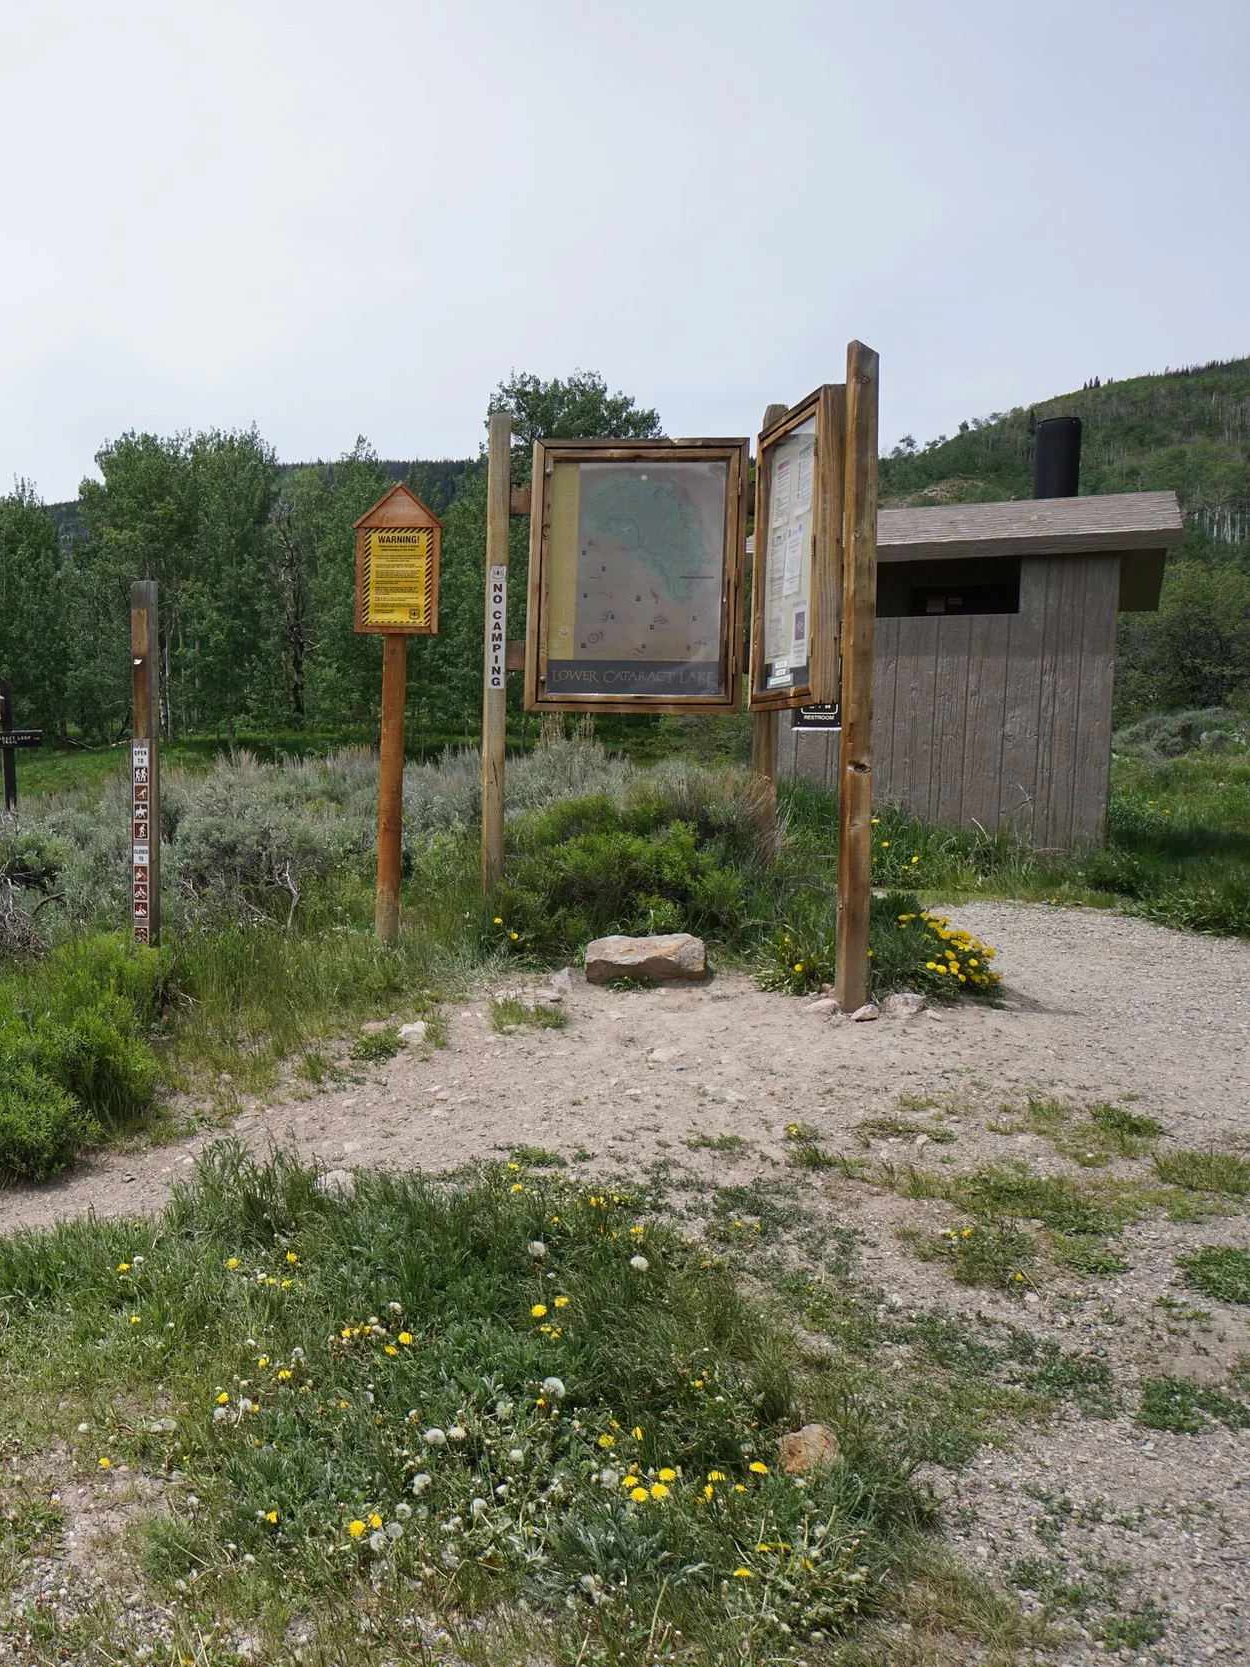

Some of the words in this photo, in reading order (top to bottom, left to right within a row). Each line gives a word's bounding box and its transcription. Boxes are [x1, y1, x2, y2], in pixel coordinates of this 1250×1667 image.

[377, 535, 420, 544] WARNING!
[492, 583, 503, 604] NO
[491, 610, 503, 686] CAMPING
[552, 670, 599, 683] LOWER
[603, 670, 676, 684] CATARACT
[679, 671, 715, 684] LAKE
